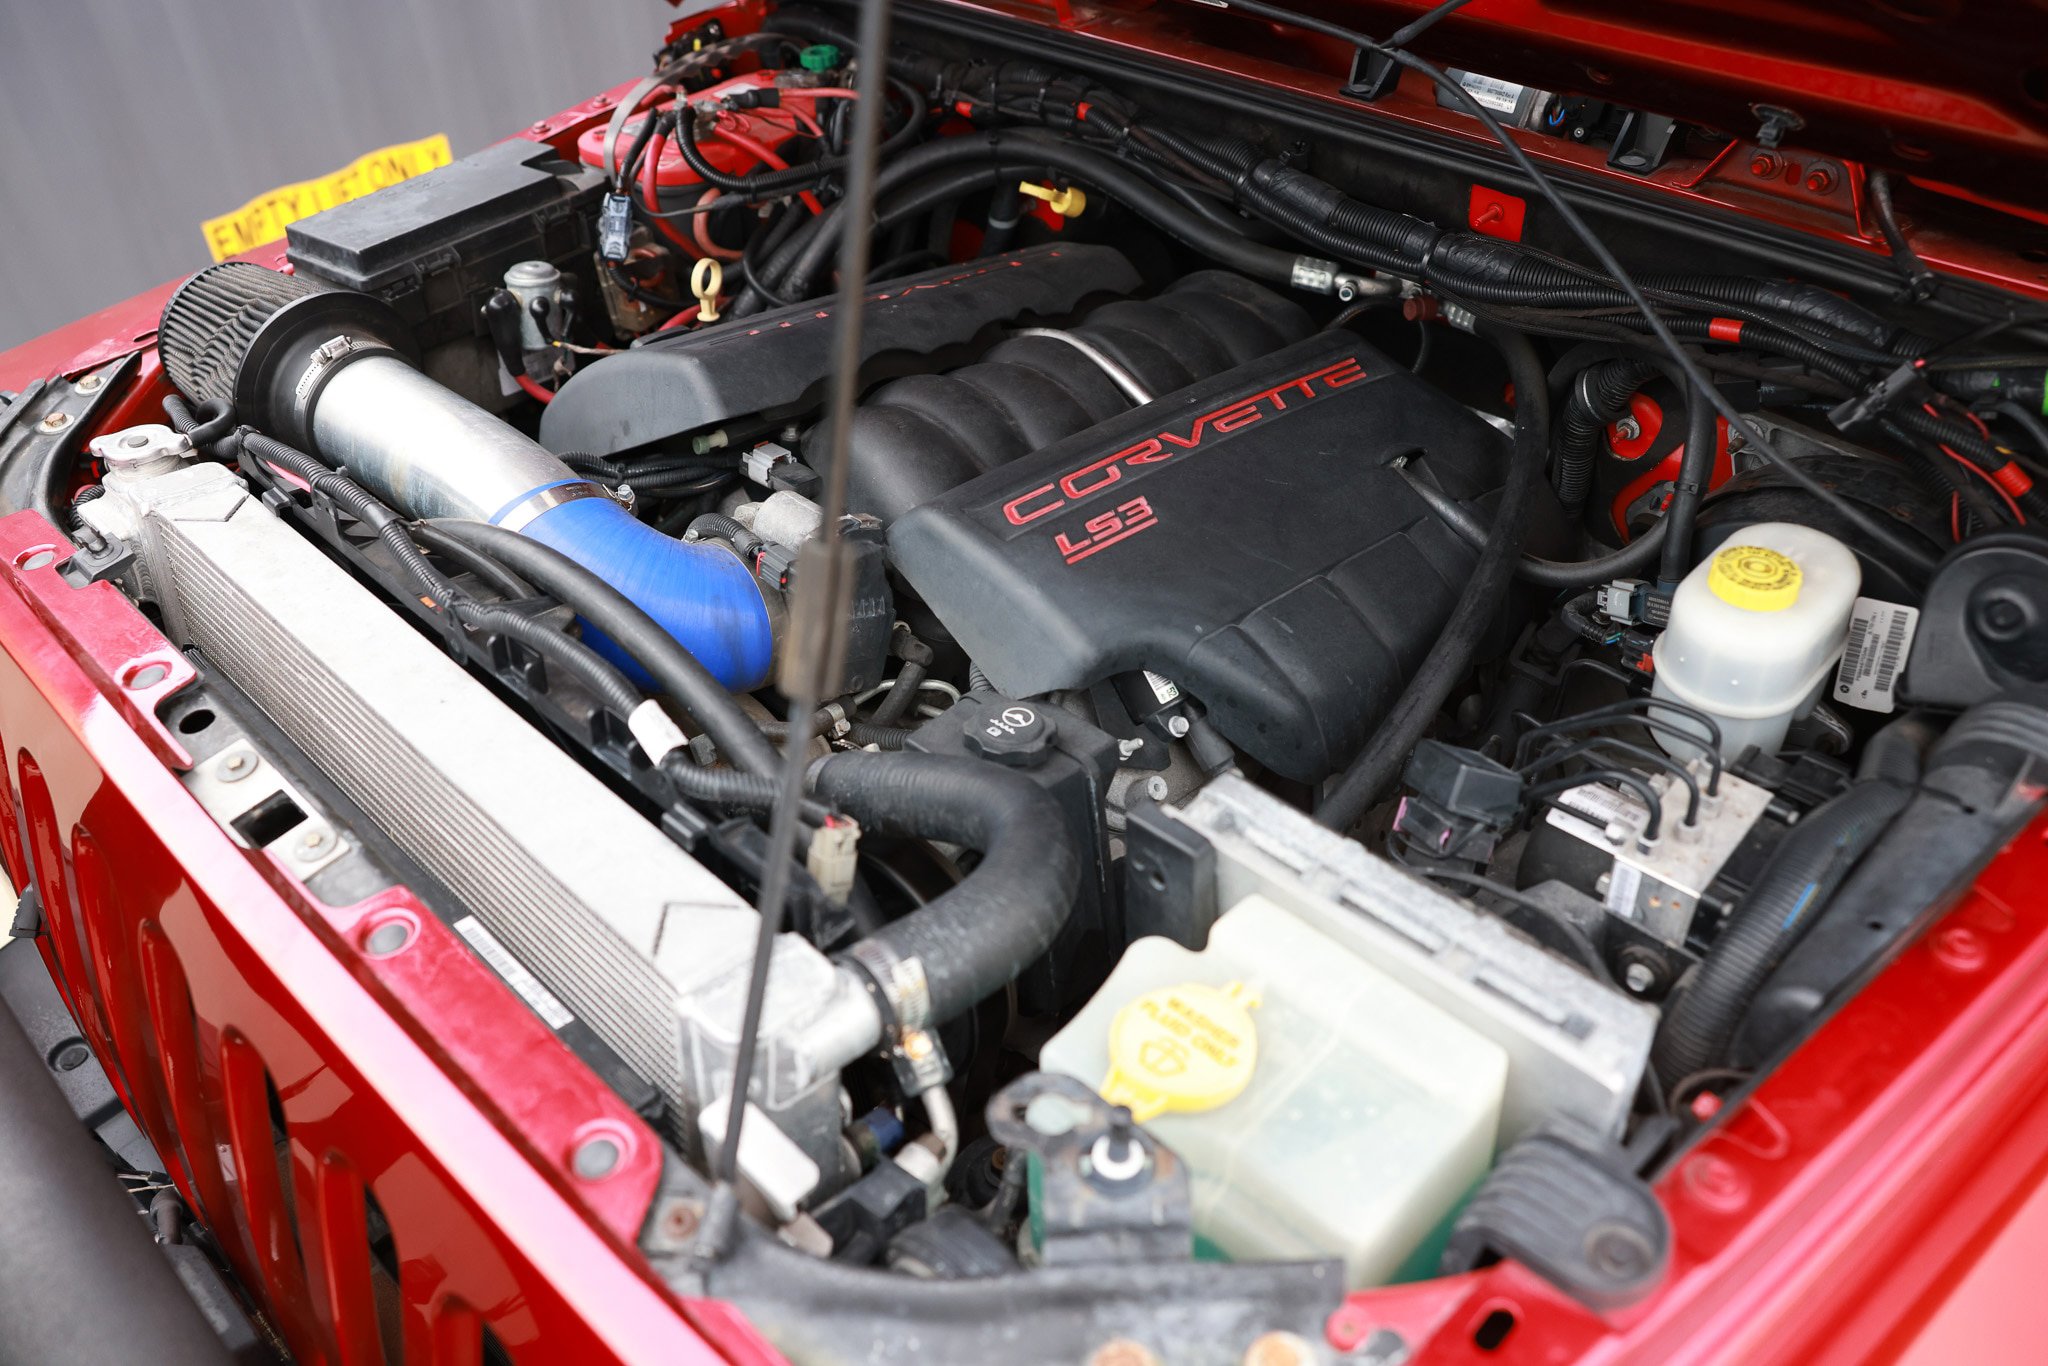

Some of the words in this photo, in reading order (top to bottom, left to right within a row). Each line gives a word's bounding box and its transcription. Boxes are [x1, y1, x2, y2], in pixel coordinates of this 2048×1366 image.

[212, 192, 301, 259] EMPTY
[1002, 357, 1367, 526] CORVETTE
[1054, 495, 1154, 557] LS3
[1140, 1000, 1192, 1037] FLUID
[1191, 1035, 1239, 1068] ONLY
[1167, 996, 1240, 1048] WASHER
